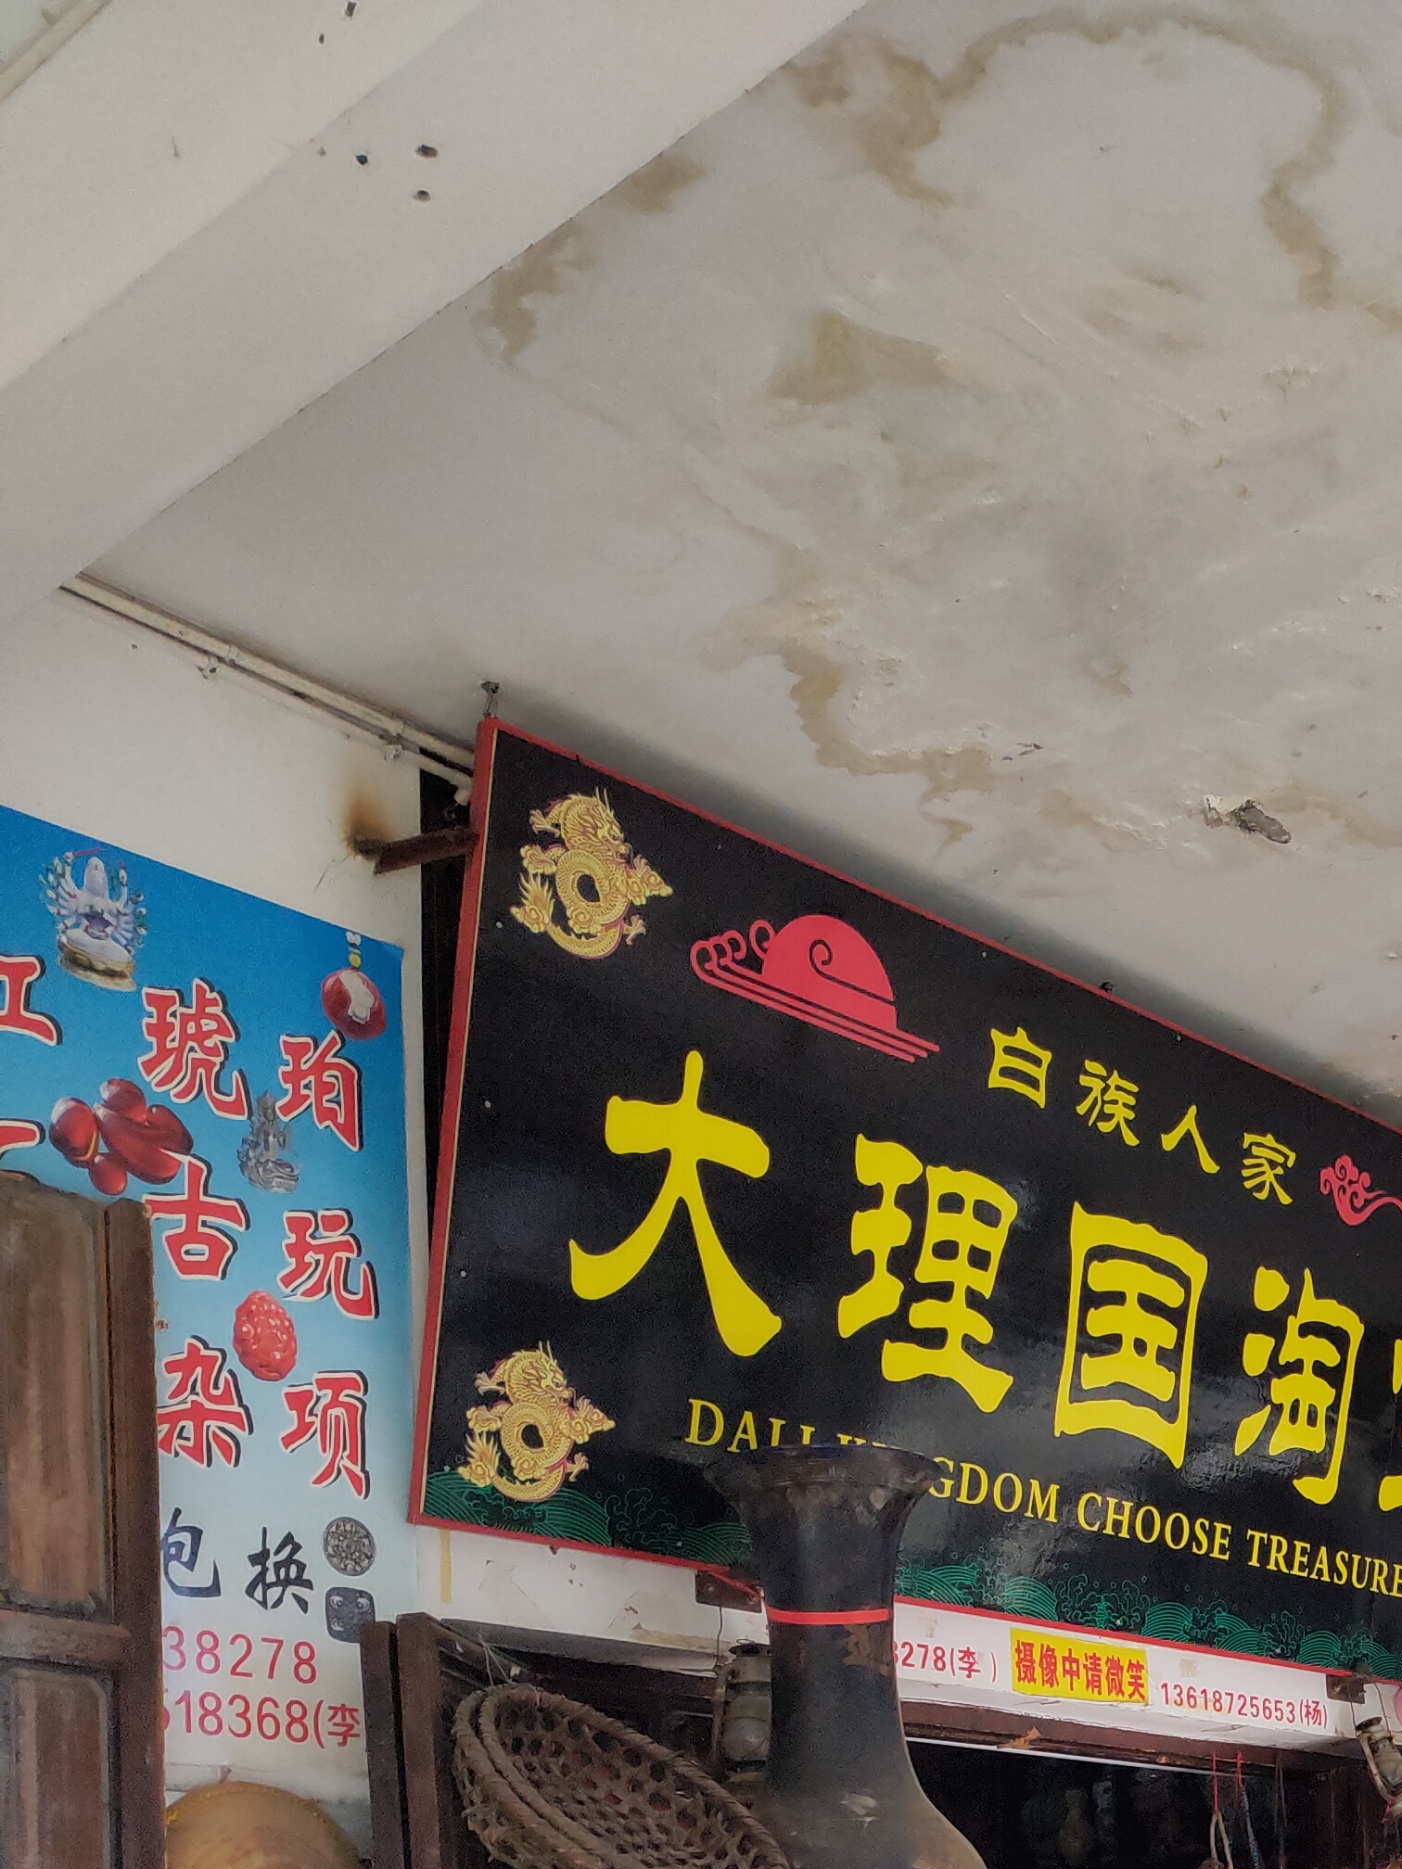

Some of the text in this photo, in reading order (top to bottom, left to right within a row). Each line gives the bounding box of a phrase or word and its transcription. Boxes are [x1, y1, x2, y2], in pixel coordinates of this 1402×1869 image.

[987, 1026, 1298, 1206] 白族人家
[143, 1154, 377, 1319] 古玩
[157, 1336, 367, 1499] 杂项
[1077, 1491, 1232, 1561] CHOOSE
[1014, 1637, 1147, 1703] 摄像中请微笑
[163, 1690, 361, 1749] 18368(李
[1160, 1682, 1329, 1731] 13618725653(杨)
